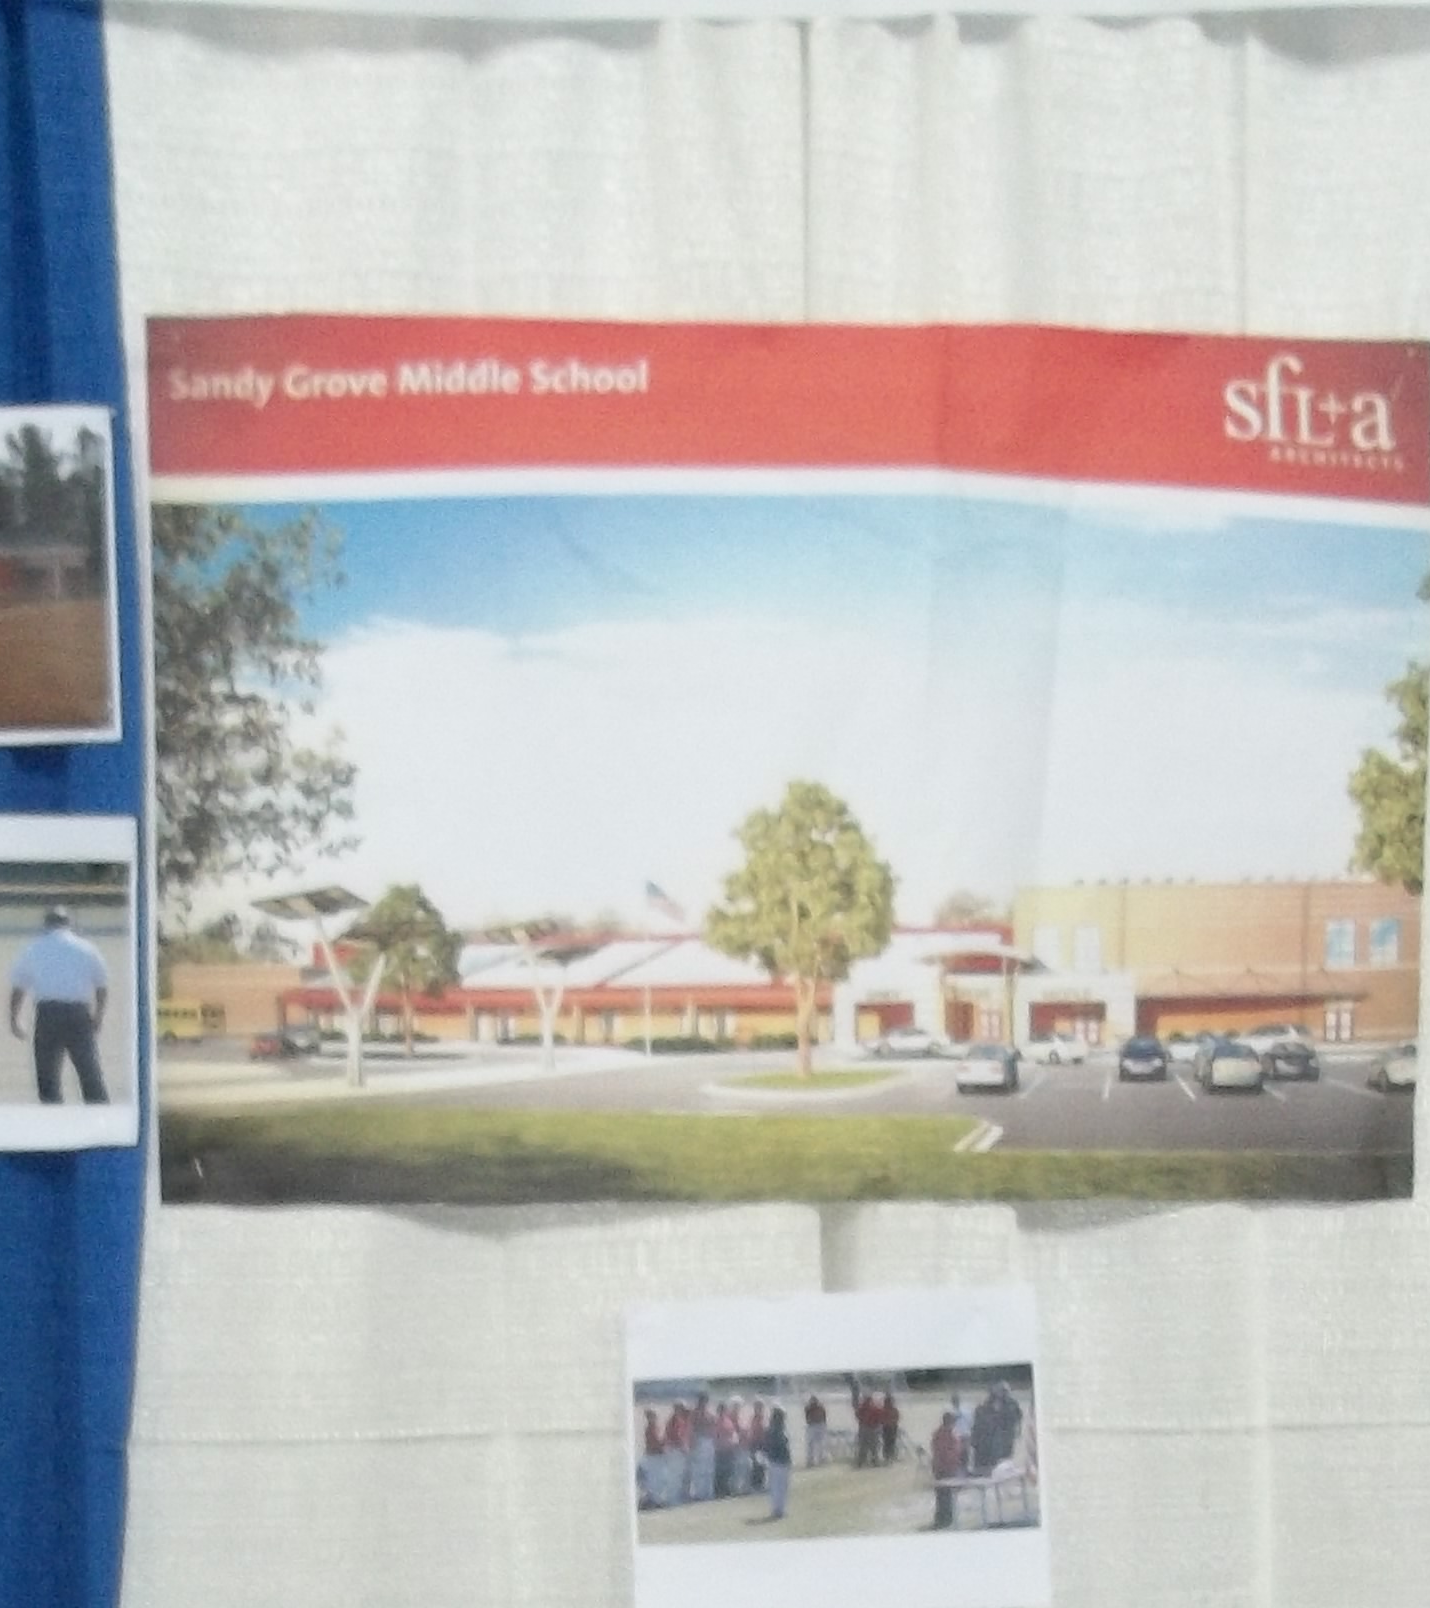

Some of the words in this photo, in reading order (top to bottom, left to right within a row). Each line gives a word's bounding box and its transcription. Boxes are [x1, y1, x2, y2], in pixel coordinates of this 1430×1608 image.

[170, 365, 273, 409] Sandy
[283, 363, 387, 399] Grove
[398, 357, 521, 397] Middle
[529, 357, 648, 394] School
